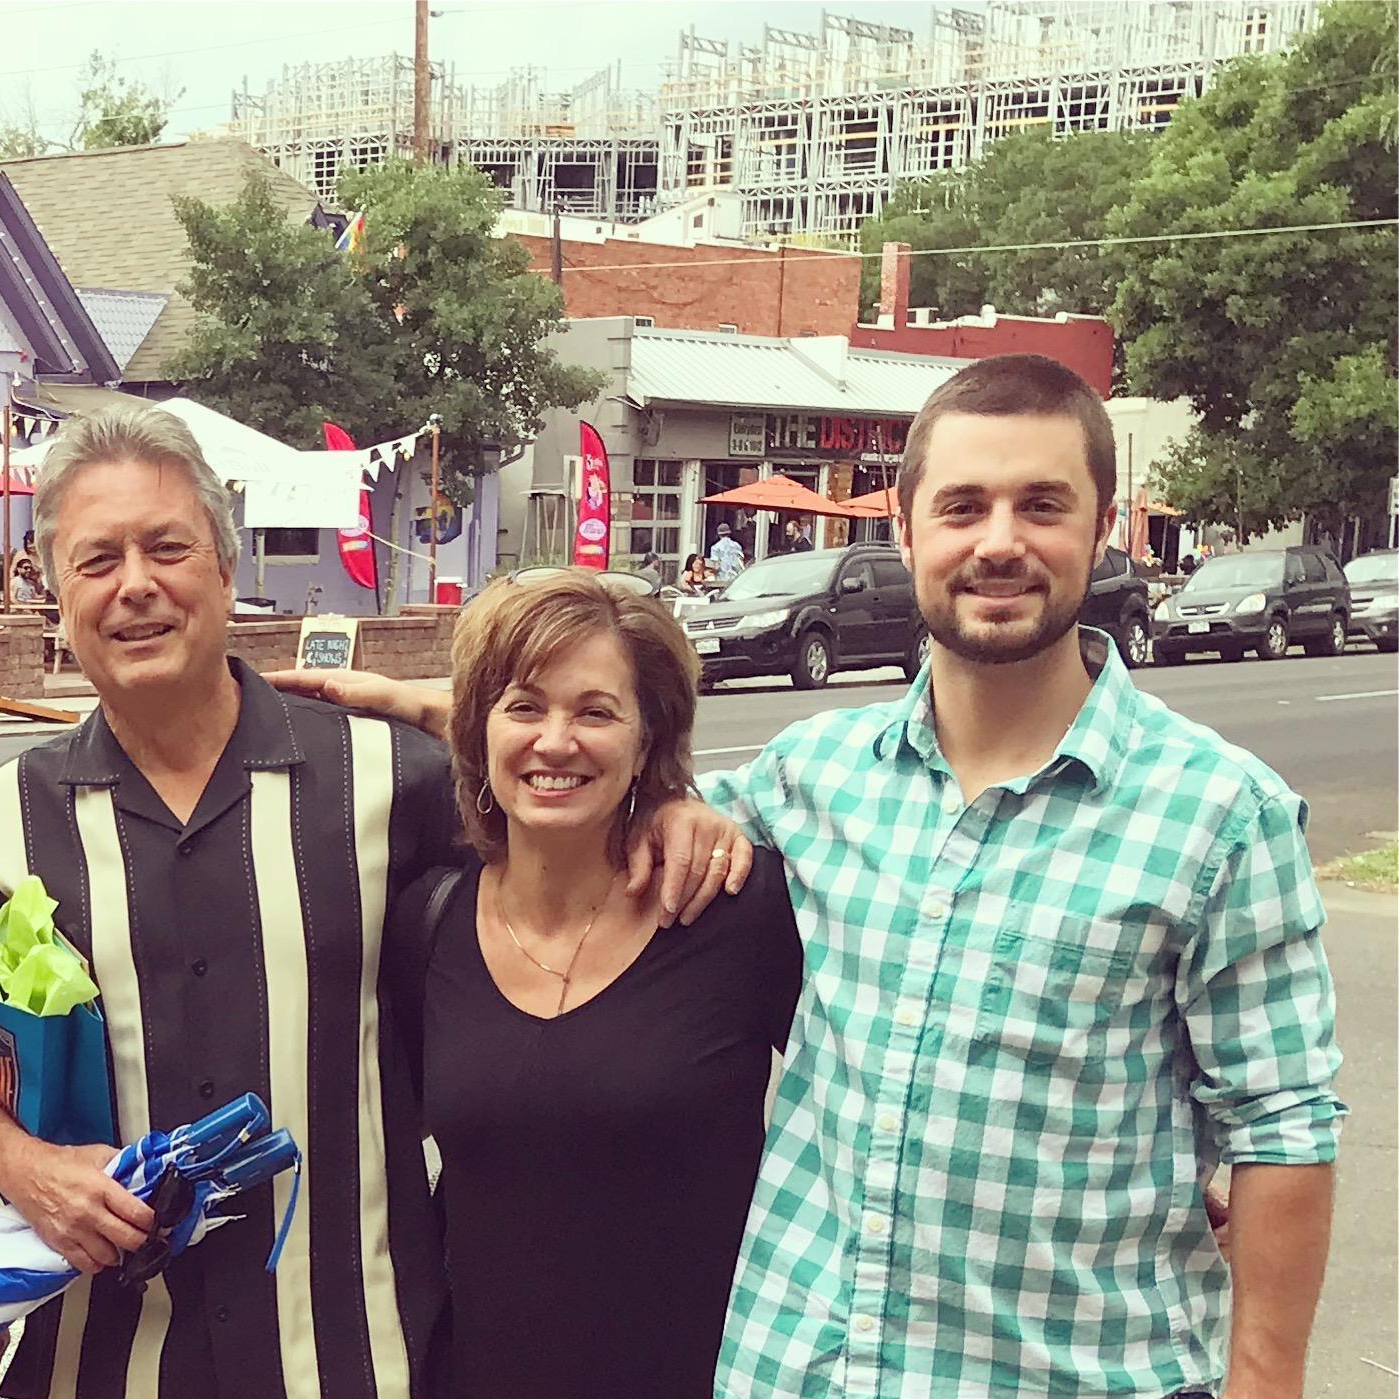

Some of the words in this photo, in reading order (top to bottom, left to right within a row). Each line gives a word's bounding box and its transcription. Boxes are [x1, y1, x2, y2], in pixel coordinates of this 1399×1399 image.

[772, 417, 817, 449] THE
[819, 416, 909, 452] DISTRIC
[305, 639, 325, 651] LATE
